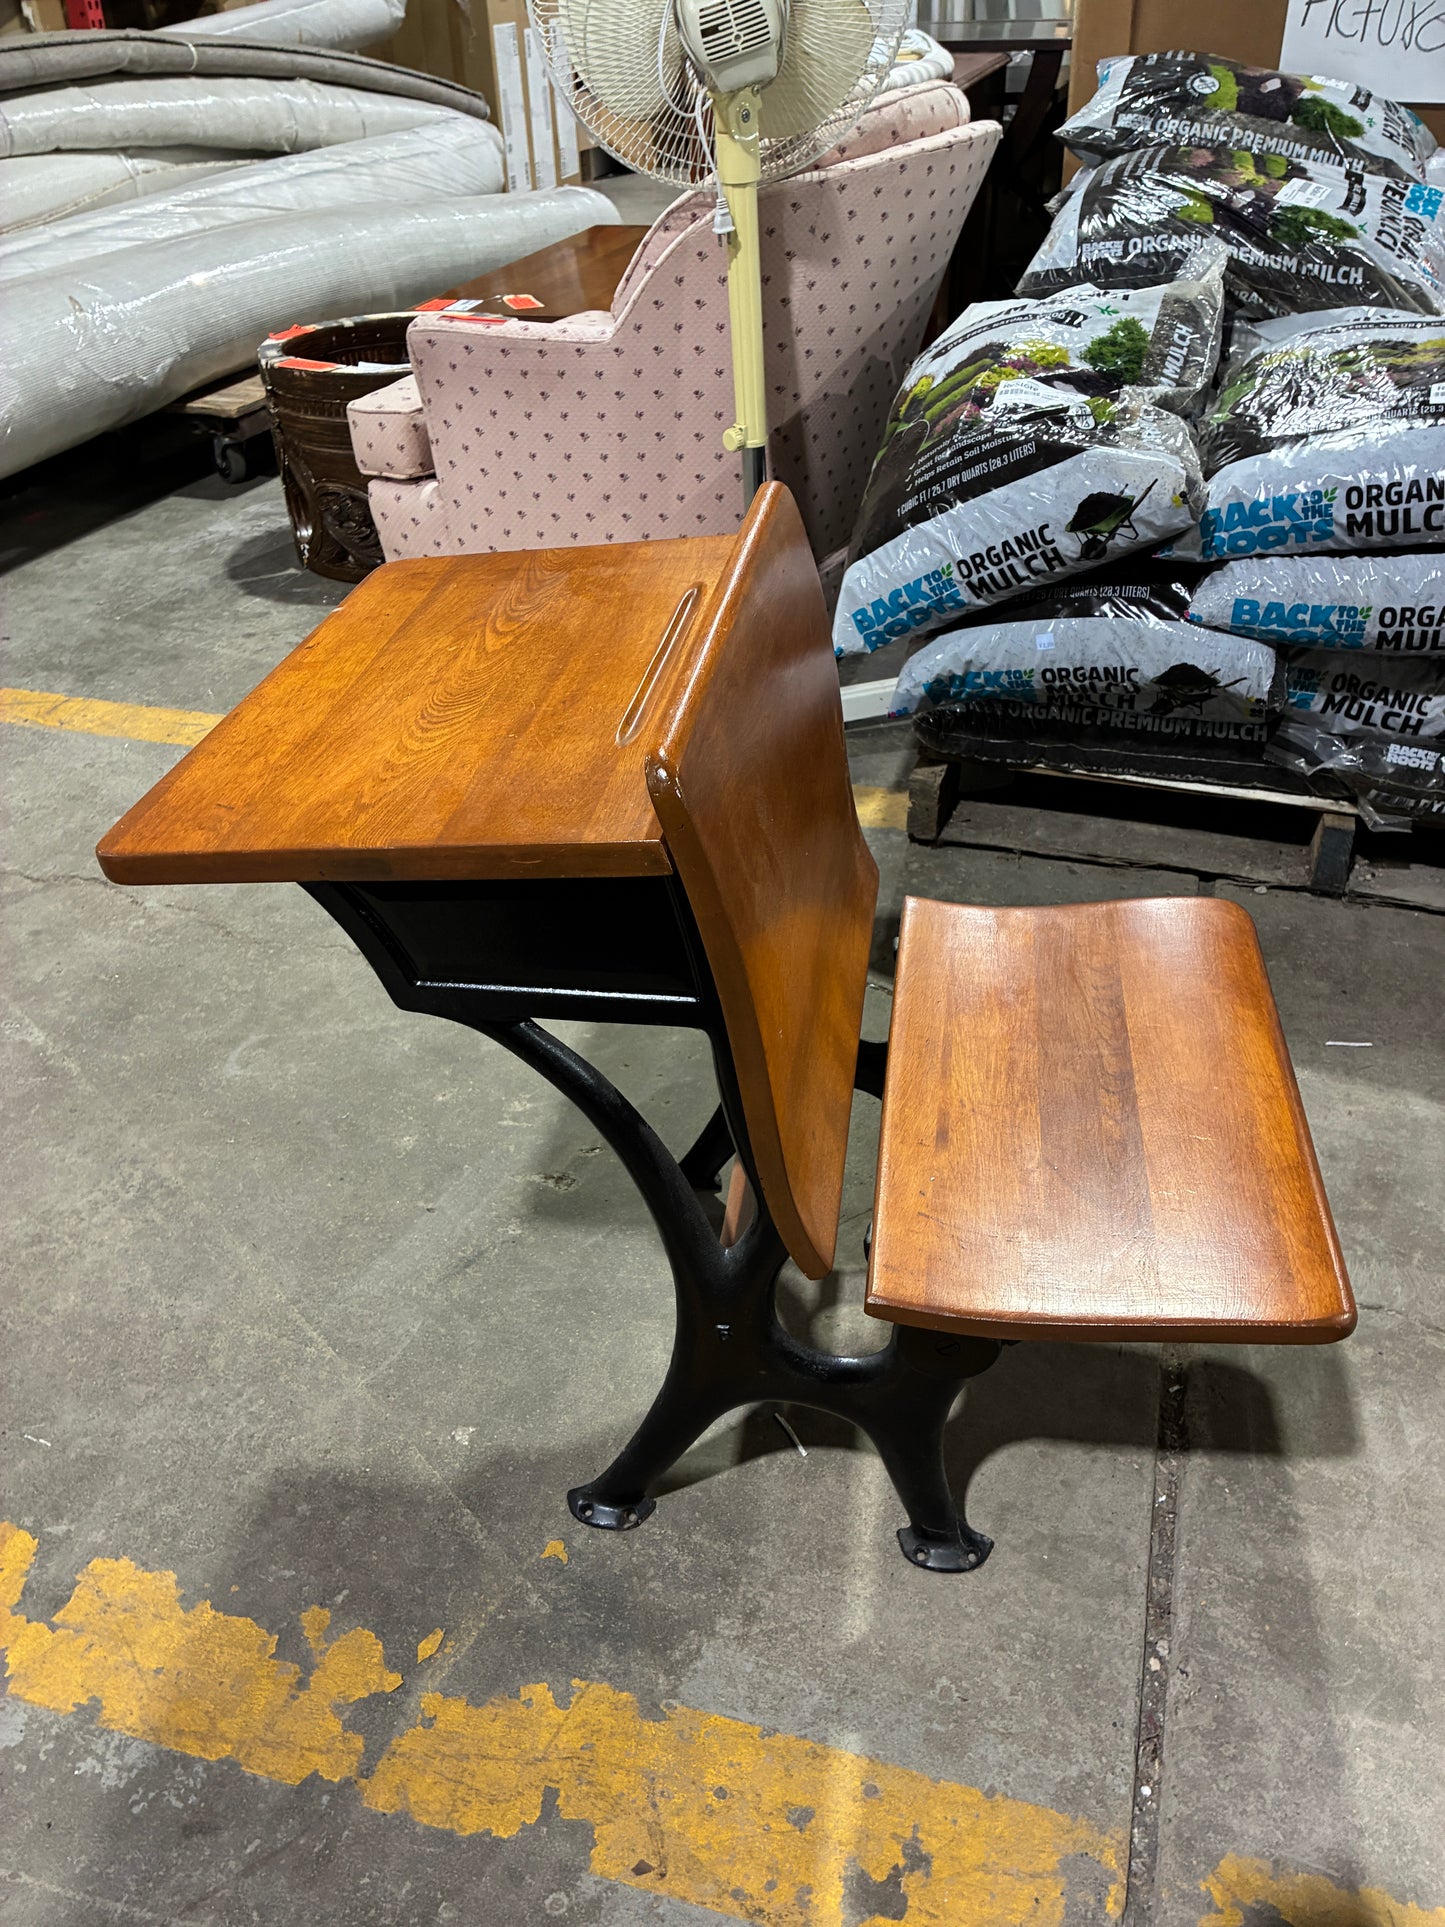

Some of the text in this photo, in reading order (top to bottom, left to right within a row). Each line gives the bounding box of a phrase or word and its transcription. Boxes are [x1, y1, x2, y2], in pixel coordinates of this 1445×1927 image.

[1155, 118, 1230, 142] ORGANIC
[1231, 126, 1308, 160] PREMIUM
[1225, 243, 1299, 274] REMIUM
[1161, 321, 1194, 380] MULCH
[900, 495, 919, 516] CUBIC
[919, 489, 927, 503] FT
[946, 473, 960, 490] DRY
[961, 461, 989, 483] QUARTS
[989, 454, 1009, 472] (28.3
[1008, 441, 1037, 463] LITERS)
[914, 469, 936, 487] Helps
[936, 454, 963, 474] Retain
[963, 447, 980, 460] Soil
[1200, 489, 1324, 539] BACK TO
[1301, 503, 1334, 521] THE
[956, 523, 1057, 581] ORGANIC
[1201, 518, 1336, 559] ROOTS
[928, 576, 958, 598] THE
[965, 546, 1068, 600] MULCH
[1121, 585, 1150, 600] LITERS)
[852, 569, 944, 635] BACK TO
[863, 588, 967, 653] ROOTS
[1231, 598, 1359, 628] BACK TO
[1336, 618, 1367, 632] THE
[1005, 669, 1023, 680] TO
[1041, 665, 1139, 684] ORGANIC
[1331, 672, 1433, 717] ORGANIC
[1007, 701, 1092, 727] ORGANIC
[1096, 710, 1191, 736] PREMIUM
[1195, 720, 1268, 743] MULCH
[1320, 693, 1425, 737] MULCH
[1386, 753, 1435, 772] ROOTS
[1388, 743, 1428, 760] BACK
